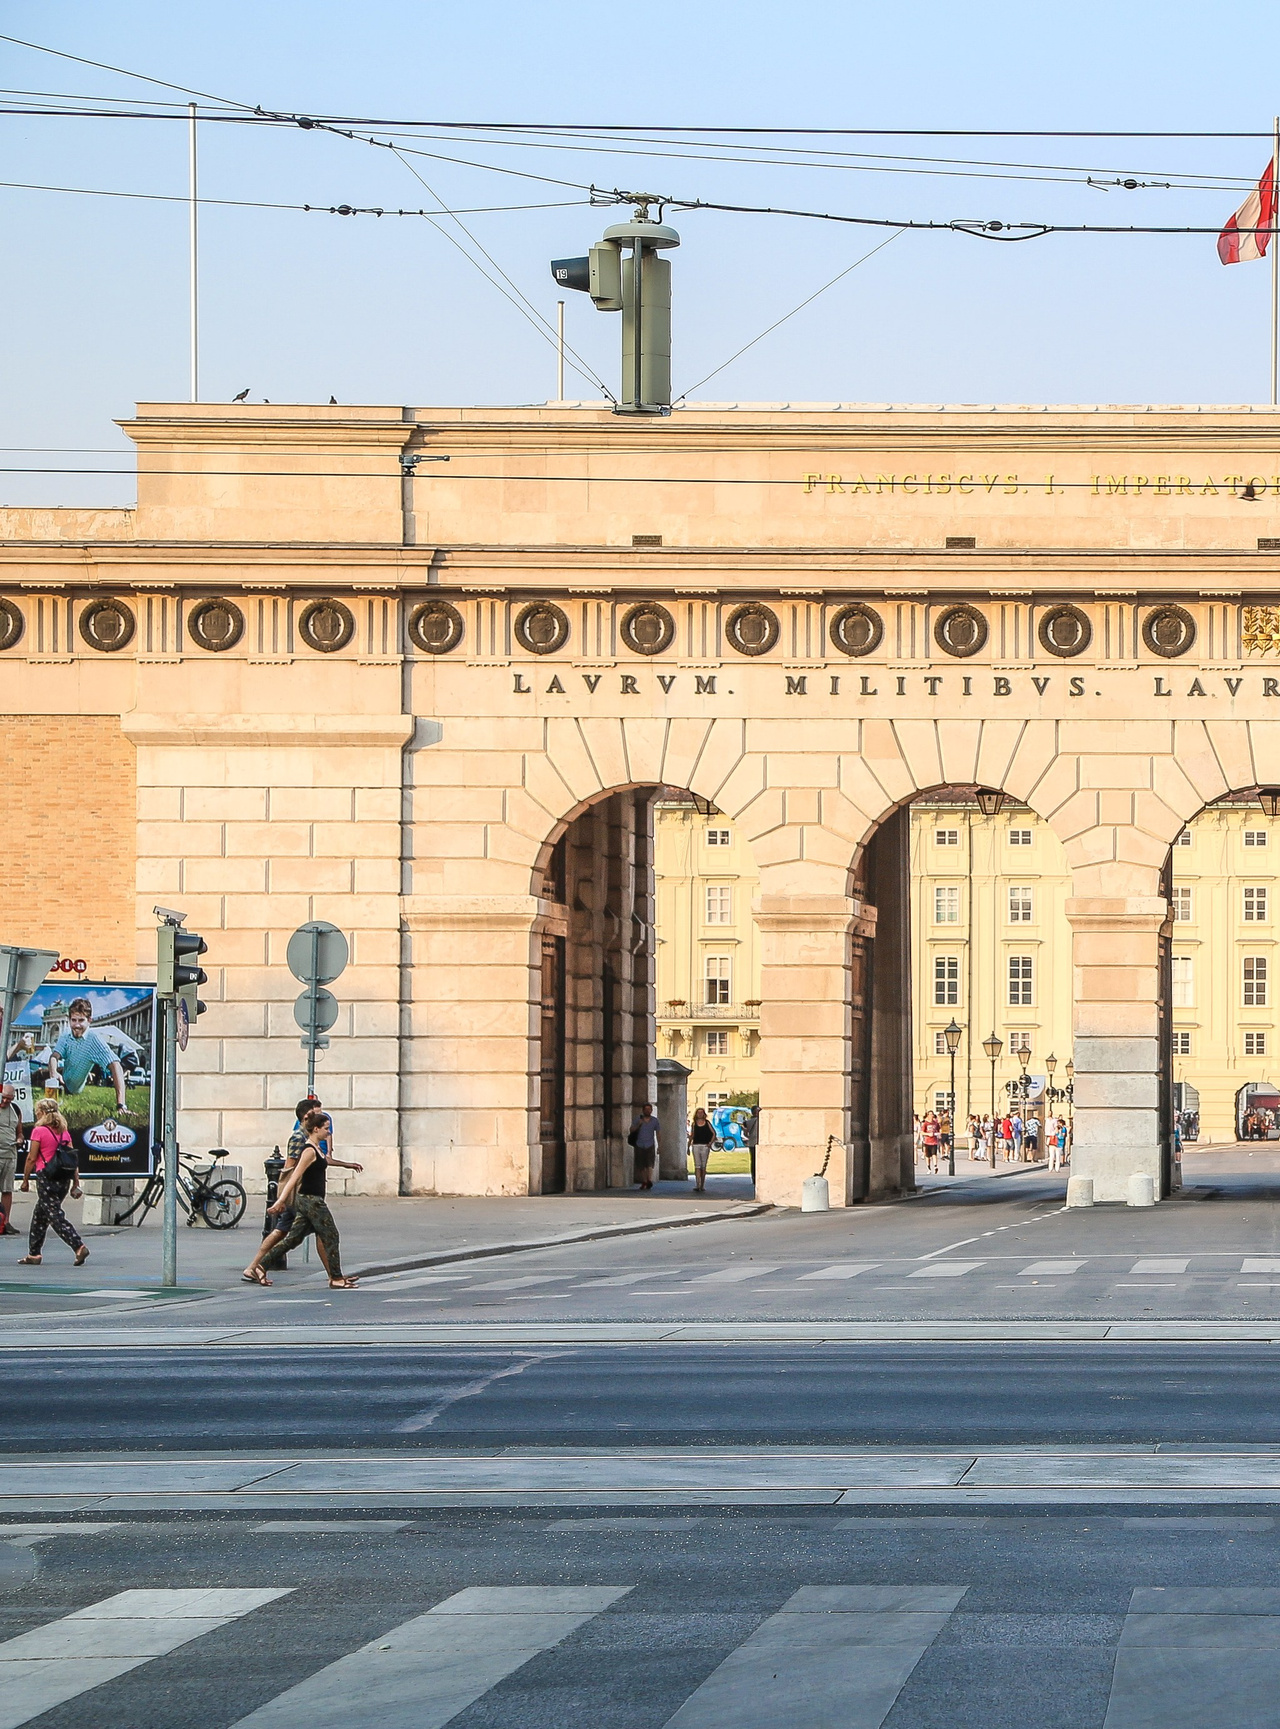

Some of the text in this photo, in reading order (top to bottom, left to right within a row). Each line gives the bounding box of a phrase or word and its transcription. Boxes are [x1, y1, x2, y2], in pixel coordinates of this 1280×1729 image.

[557, 269, 567, 279] 19
[802, 473, 1028, 494] FRANCISCVS.
[1044, 474, 1066, 495] I.
[512, 674, 735, 695] LAVRVM.
[785, 675, 1102, 696] MILITIBVS.
[3, 1068, 24, 1081] our
[89, 1130, 132, 1143] Zwettler
